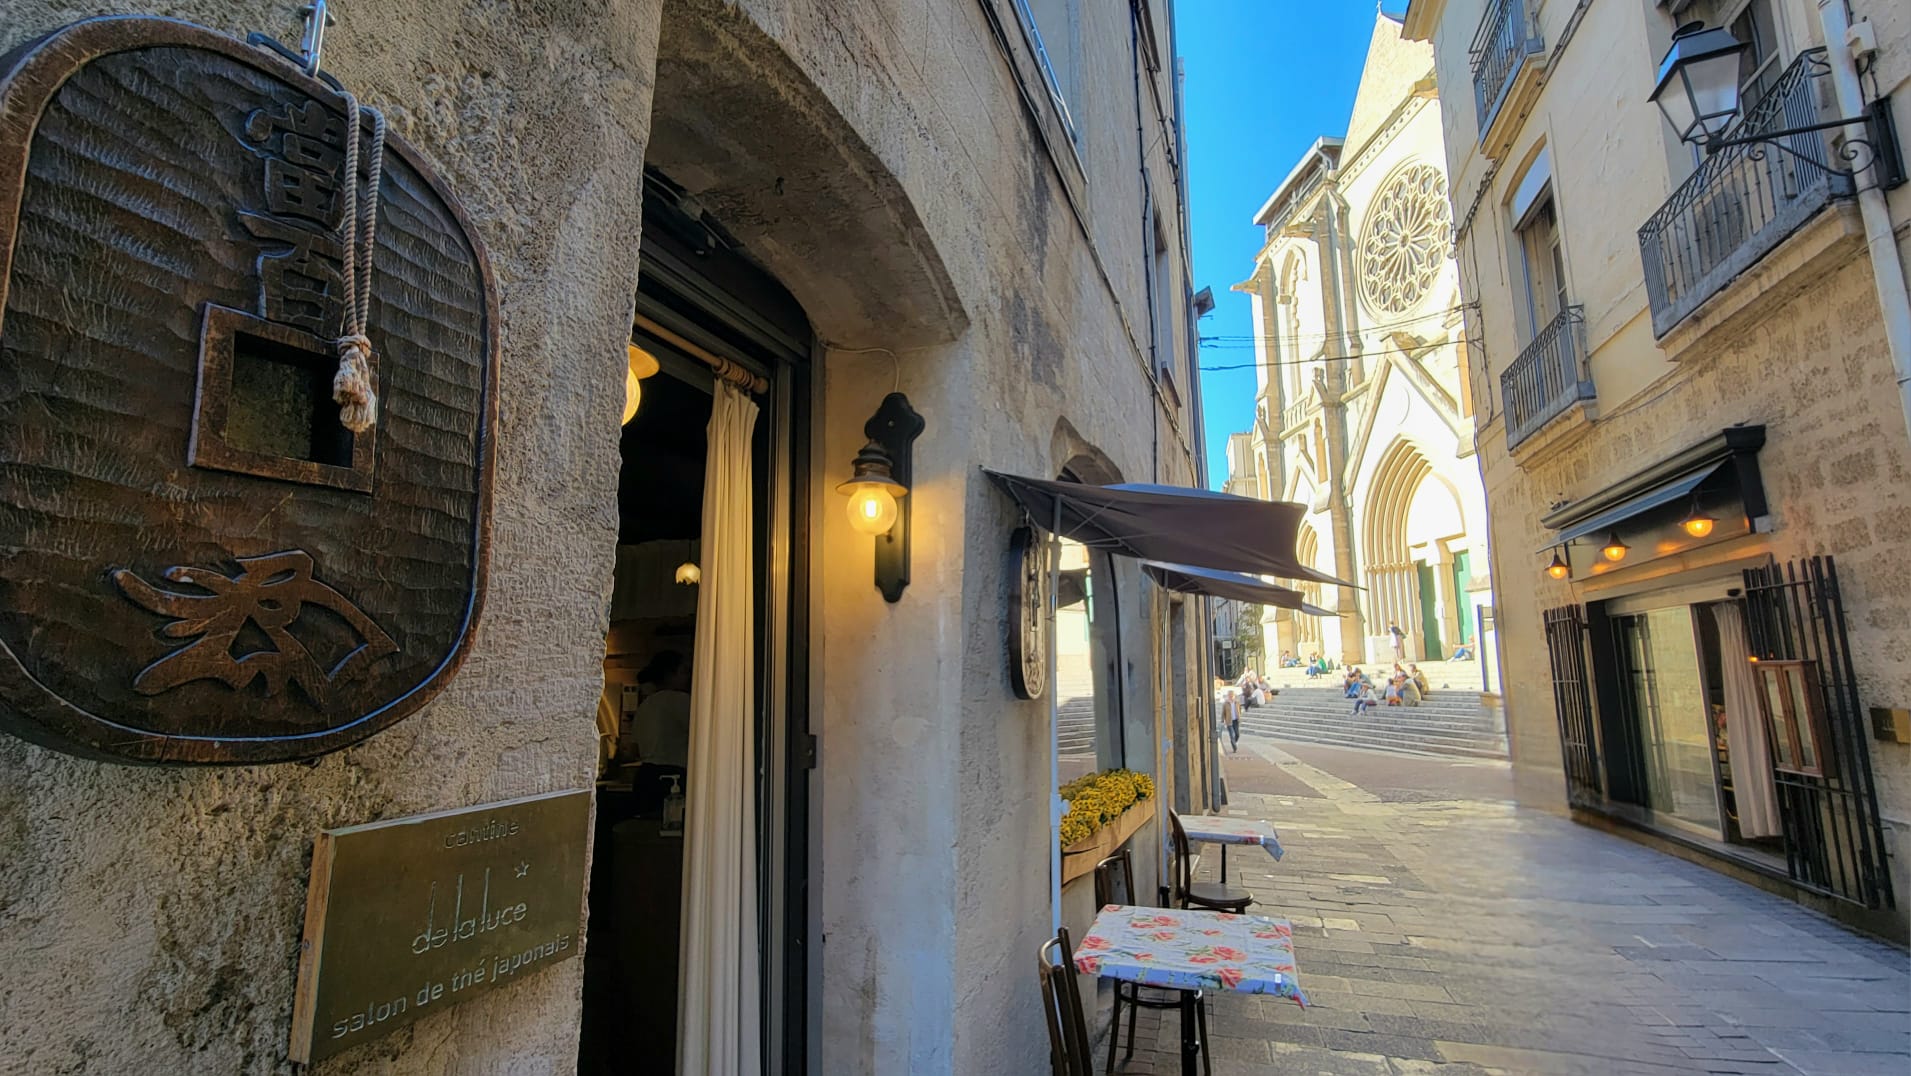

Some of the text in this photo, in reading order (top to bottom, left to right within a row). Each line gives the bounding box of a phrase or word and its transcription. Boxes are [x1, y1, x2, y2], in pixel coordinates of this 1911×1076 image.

[444, 819, 520, 849] cantine
[331, 933, 570, 1039] salon de thé japonais
